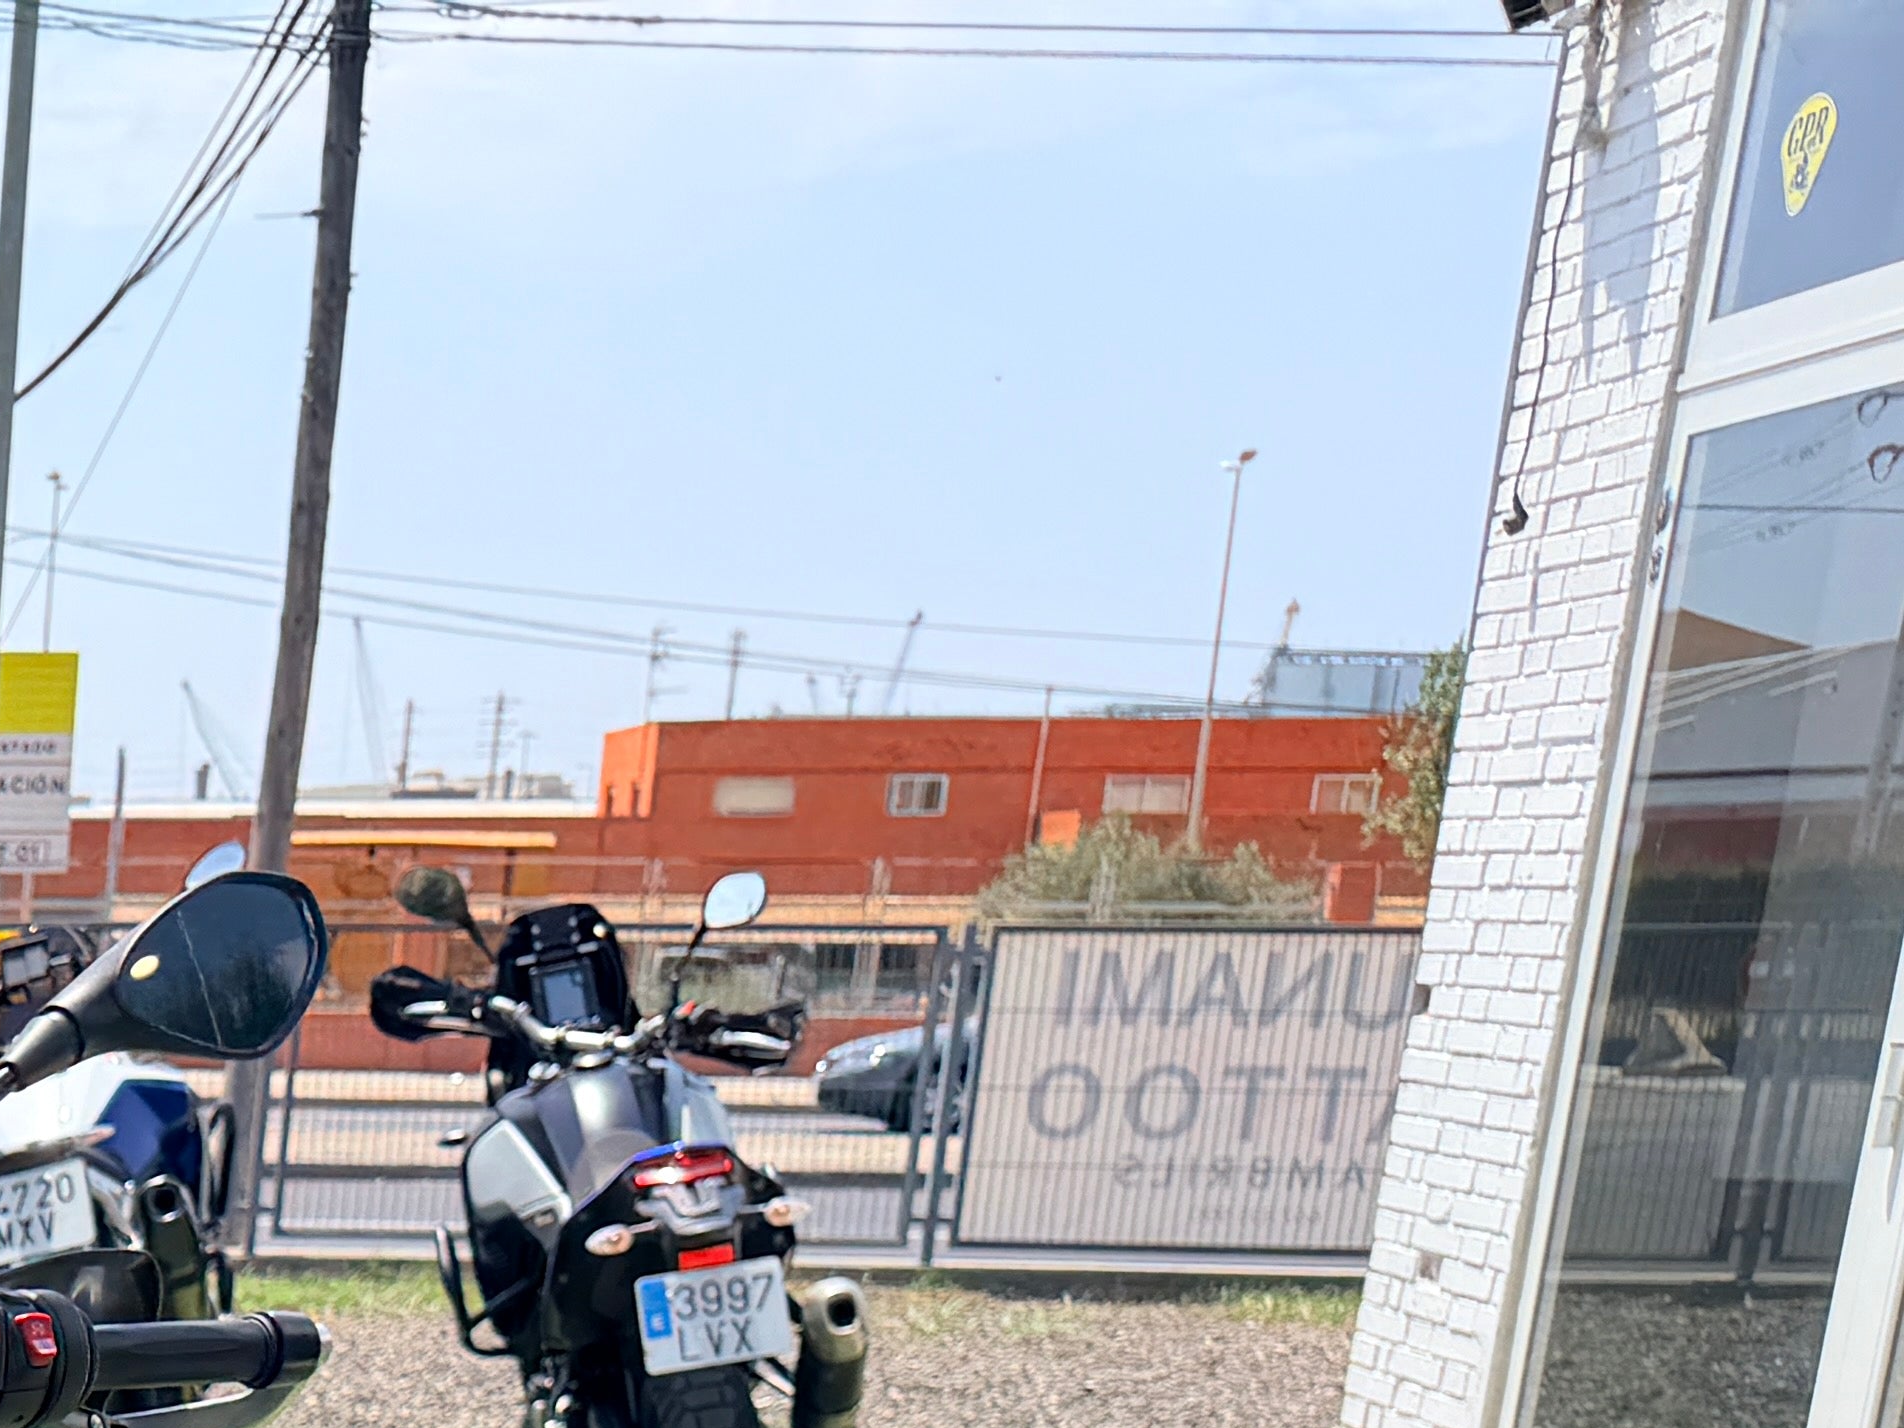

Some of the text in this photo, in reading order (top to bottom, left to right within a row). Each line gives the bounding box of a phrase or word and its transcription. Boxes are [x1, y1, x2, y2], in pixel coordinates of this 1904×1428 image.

[1788, 106, 1829, 157] GPR
[673, 1271, 774, 1322] 3997
[677, 1316, 754, 1362] LVX
